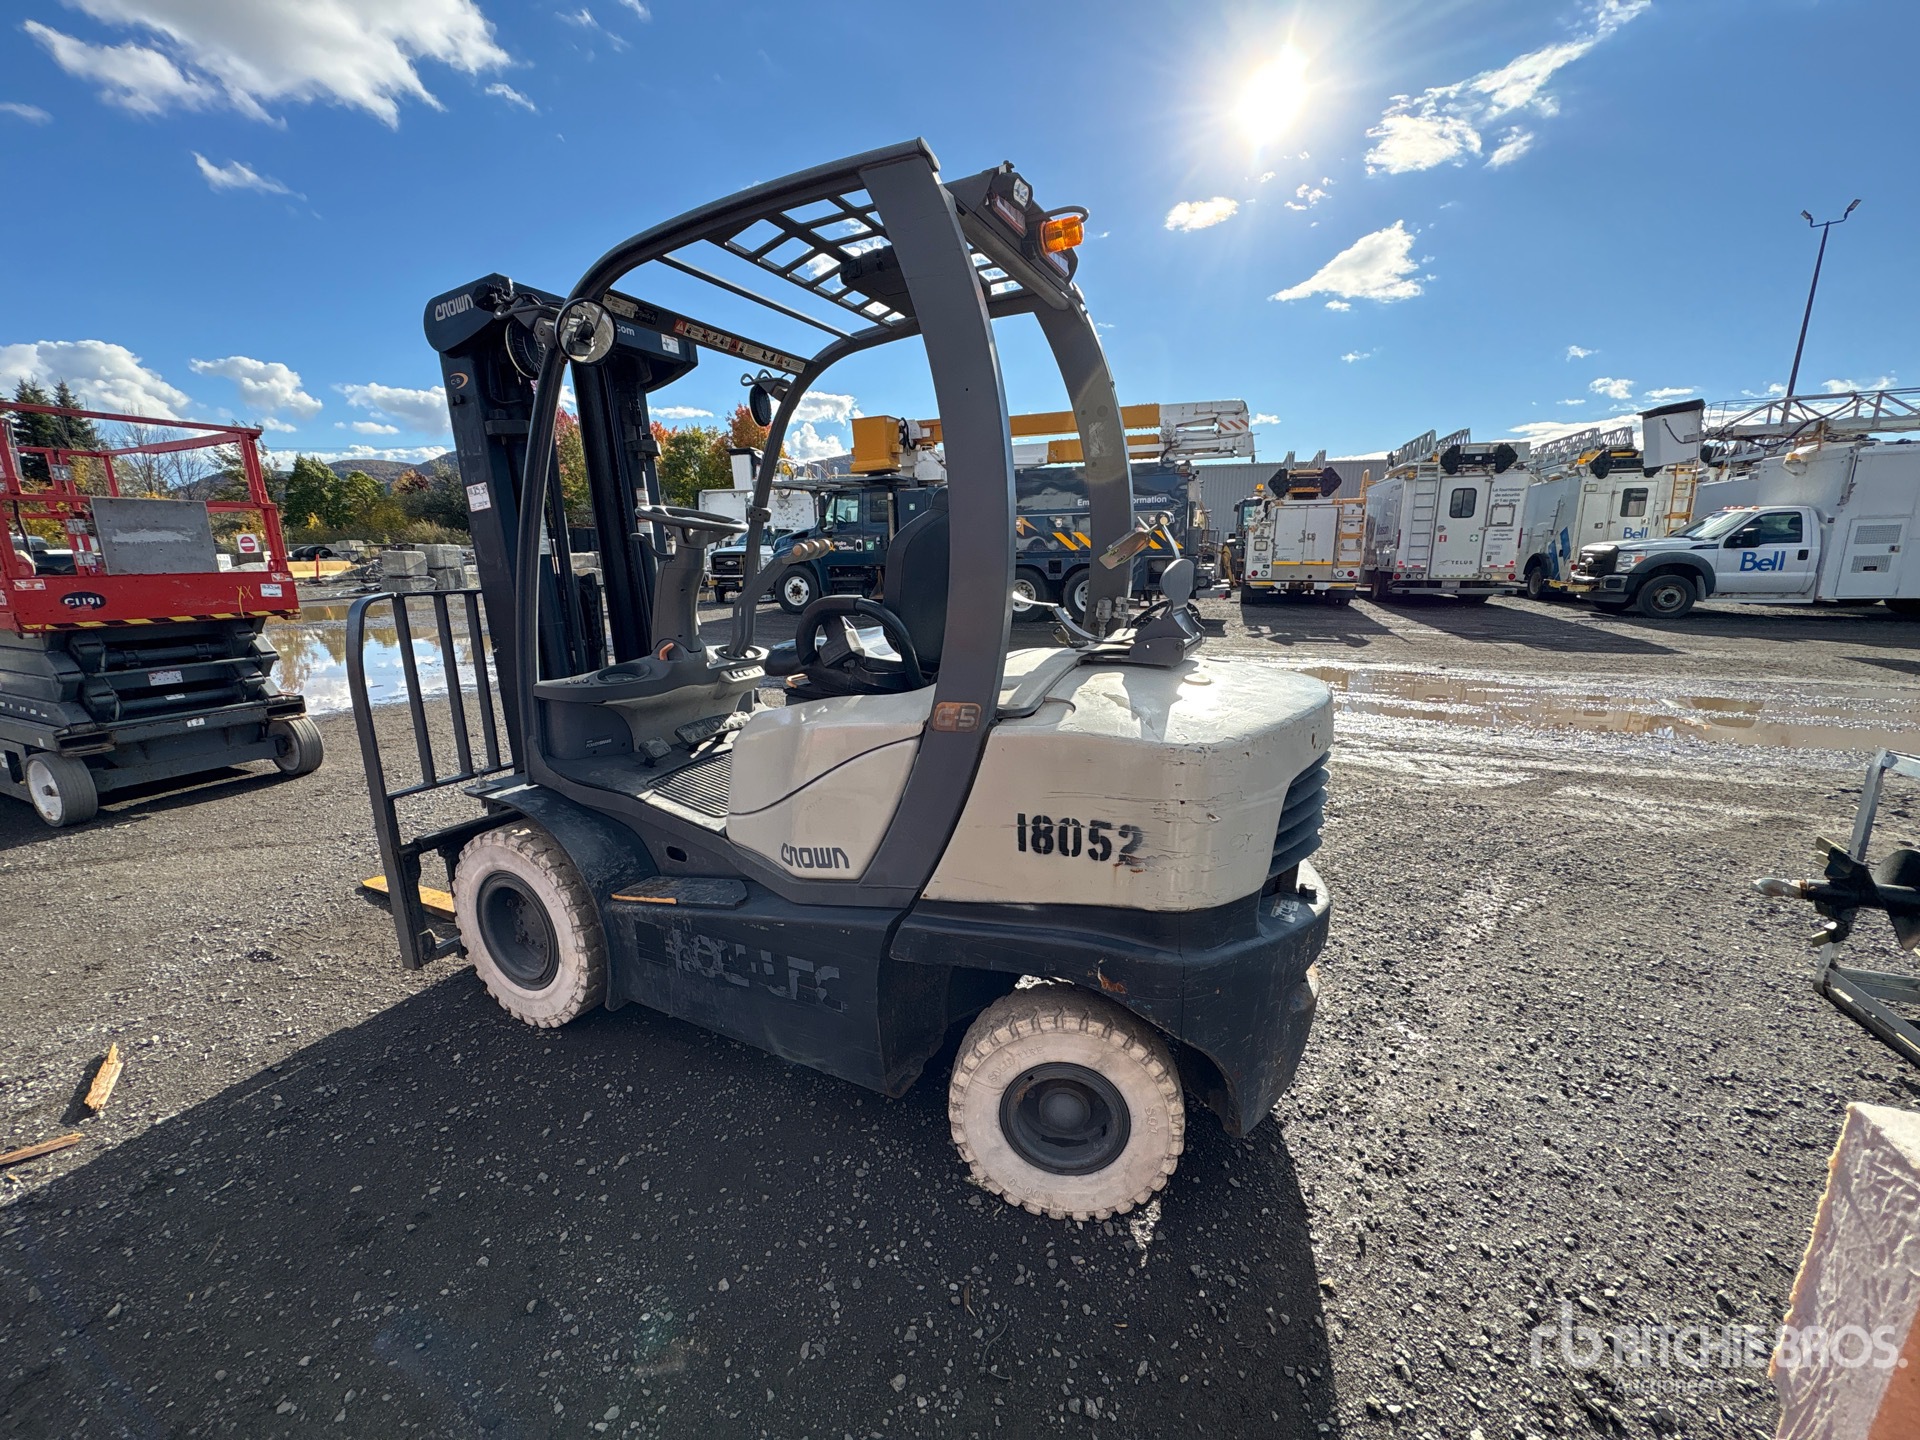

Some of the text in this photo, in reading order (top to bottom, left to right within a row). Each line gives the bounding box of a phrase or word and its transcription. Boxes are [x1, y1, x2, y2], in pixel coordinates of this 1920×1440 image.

[434, 294, 475, 321] CROWN
[1623, 527, 1648, 539] Bell
[1740, 551, 1787, 572] Bell
[1017, 812, 1144, 866] 18052
[780, 843, 850, 869] CROWN
